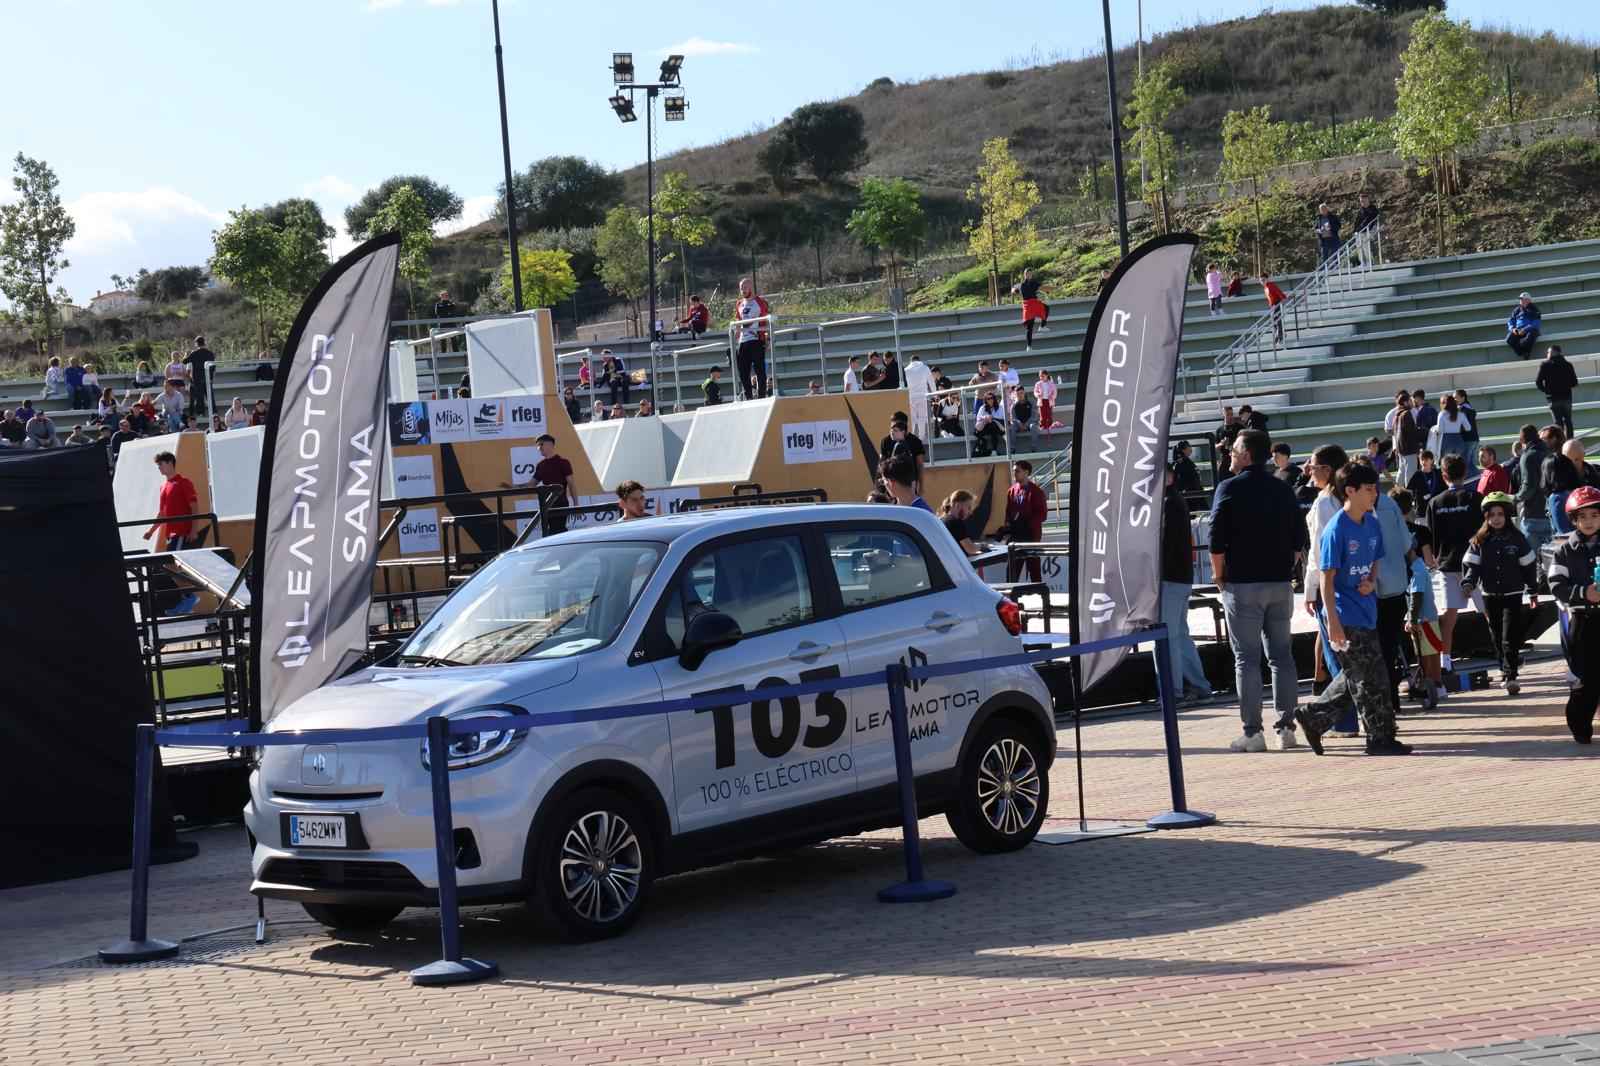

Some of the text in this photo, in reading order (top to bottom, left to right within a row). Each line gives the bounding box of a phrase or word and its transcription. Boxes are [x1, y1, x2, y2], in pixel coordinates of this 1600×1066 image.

[435, 410, 464, 428] Mijas
[511, 405, 542, 423] rfeg
[786, 432, 814, 449] rfeg
[822, 430, 847, 447] Mijas
[1091, 309, 1131, 584] LEAPMOTOR
[286, 334, 335, 627] LEAPMOTOR
[1129, 404, 1161, 528] SAMA
[342, 424, 375, 562] SAMA
[401, 522, 437, 535] divina
[634, 650, 645, 658] EV
[691, 664, 847, 770] T03
[855, 689, 980, 733] LEAMOTOR
[907, 721, 940, 743] AMA
[700, 752, 853, 805] 100 % ELÉCTRICO
